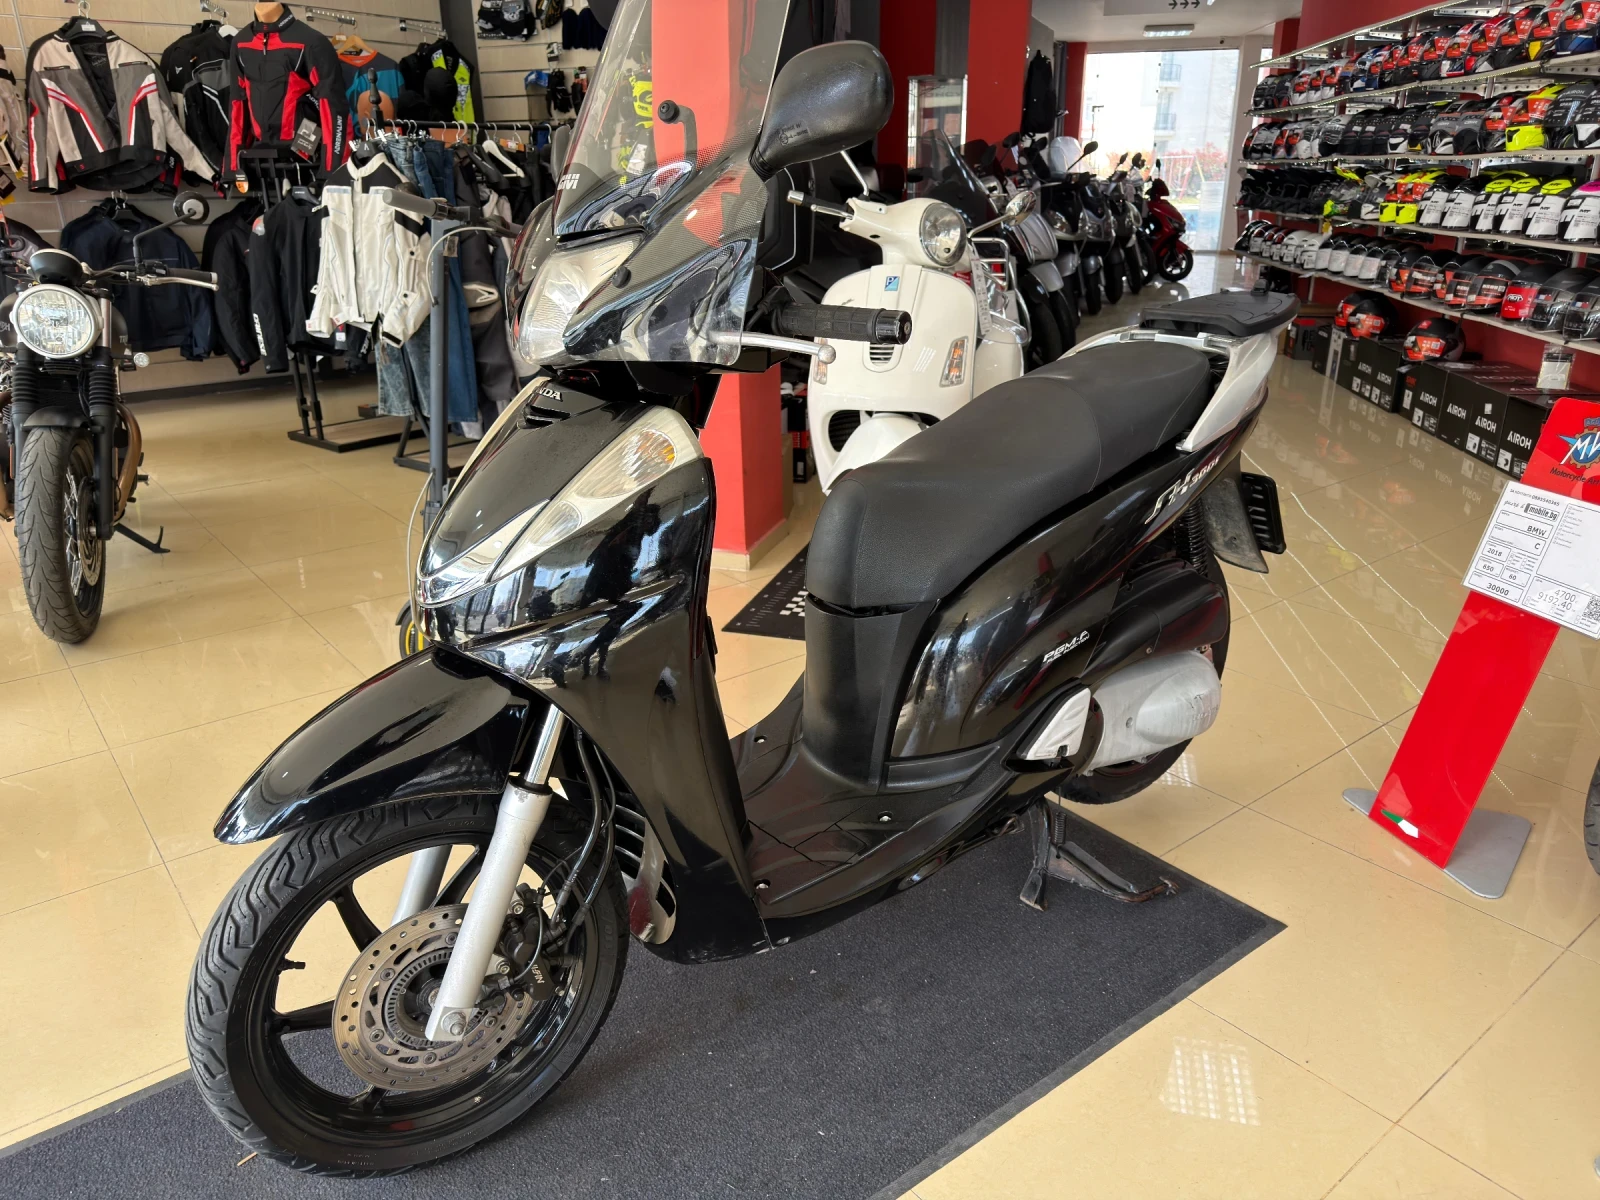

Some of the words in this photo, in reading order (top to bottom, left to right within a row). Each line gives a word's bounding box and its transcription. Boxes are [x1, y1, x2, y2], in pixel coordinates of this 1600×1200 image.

[1357, 361, 1372, 374] AIROH
[1376, 371, 1392, 386] AIROH
[1419, 391, 1438, 407] AIROH
[1446, 402, 1467, 420] AIROH
[1475, 415, 1497, 433] AIROH
[1506, 430, 1533, 450] AIROH
[1550, 467, 1587, 482] Motorcycle
[1528, 504, 1558, 521] mobile.bg
[1527, 525, 1547, 536] BMW
[1487, 548, 1503, 557] 2018
[1482, 563, 1494, 572] 650
[1508, 573, 1517, 581] 60
[1486, 583, 1509, 596] 30000
[1554, 589, 1576, 603] 4700
[1538, 591, 1573, 611] 9192.40
